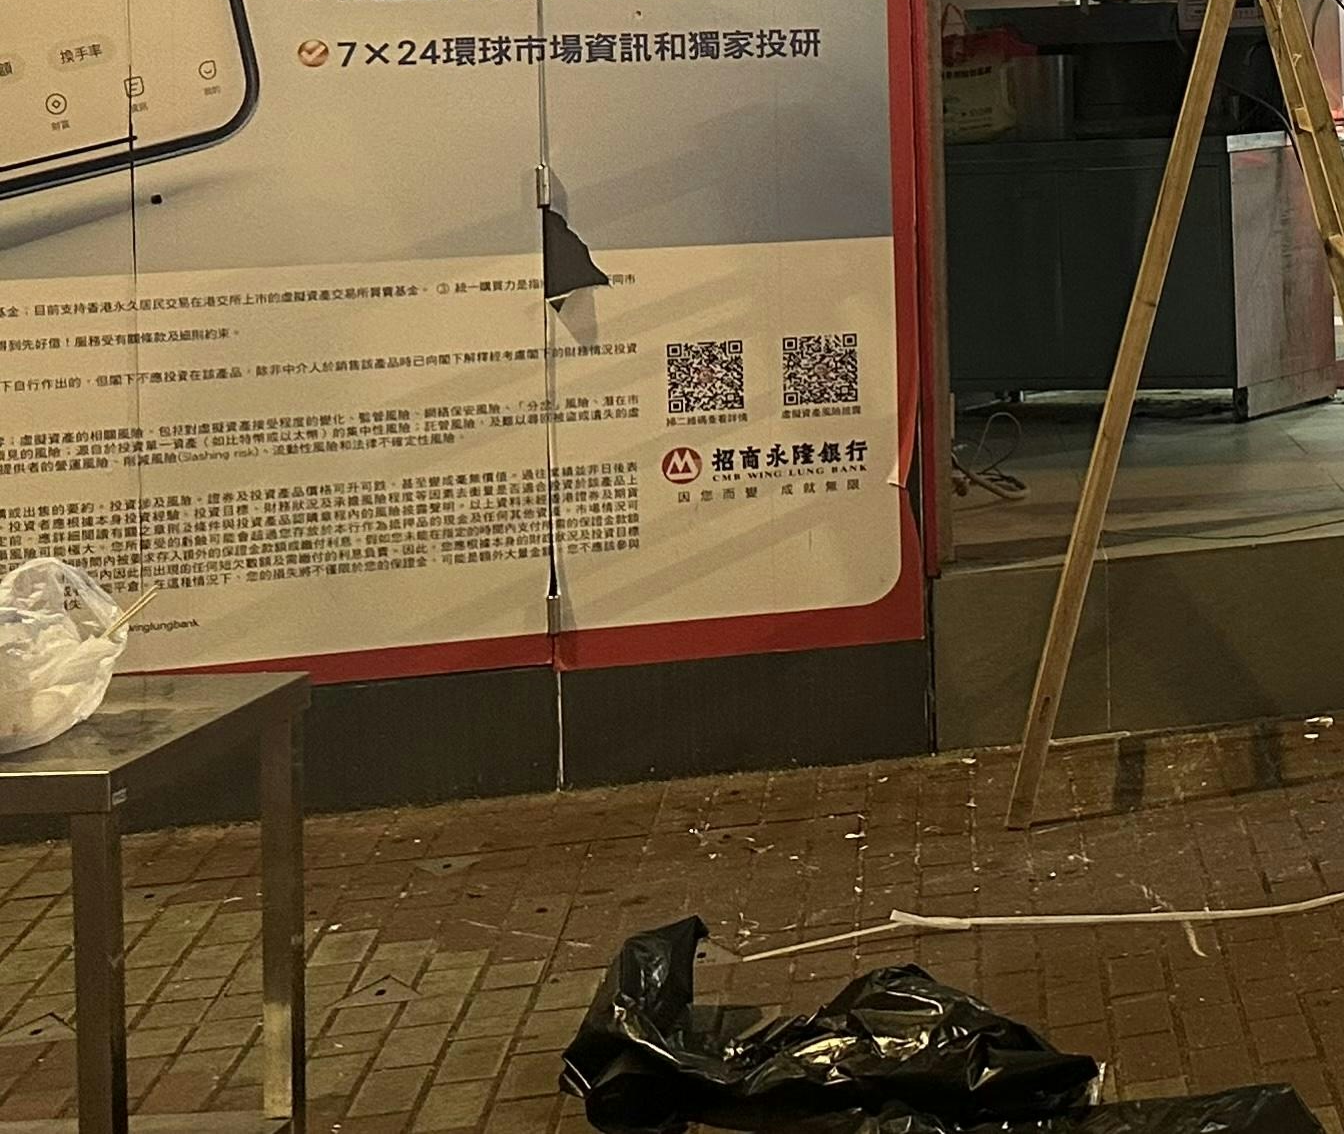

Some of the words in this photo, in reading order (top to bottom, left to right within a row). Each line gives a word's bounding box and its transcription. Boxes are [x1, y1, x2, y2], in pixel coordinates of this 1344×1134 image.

[711, 439, 869, 473] 招商永隆銀行
[711, 473, 741, 483] CMB
[747, 470, 783, 480] WING
[788, 466, 826, 477] LUNG
[831, 463, 869, 474] BANK
